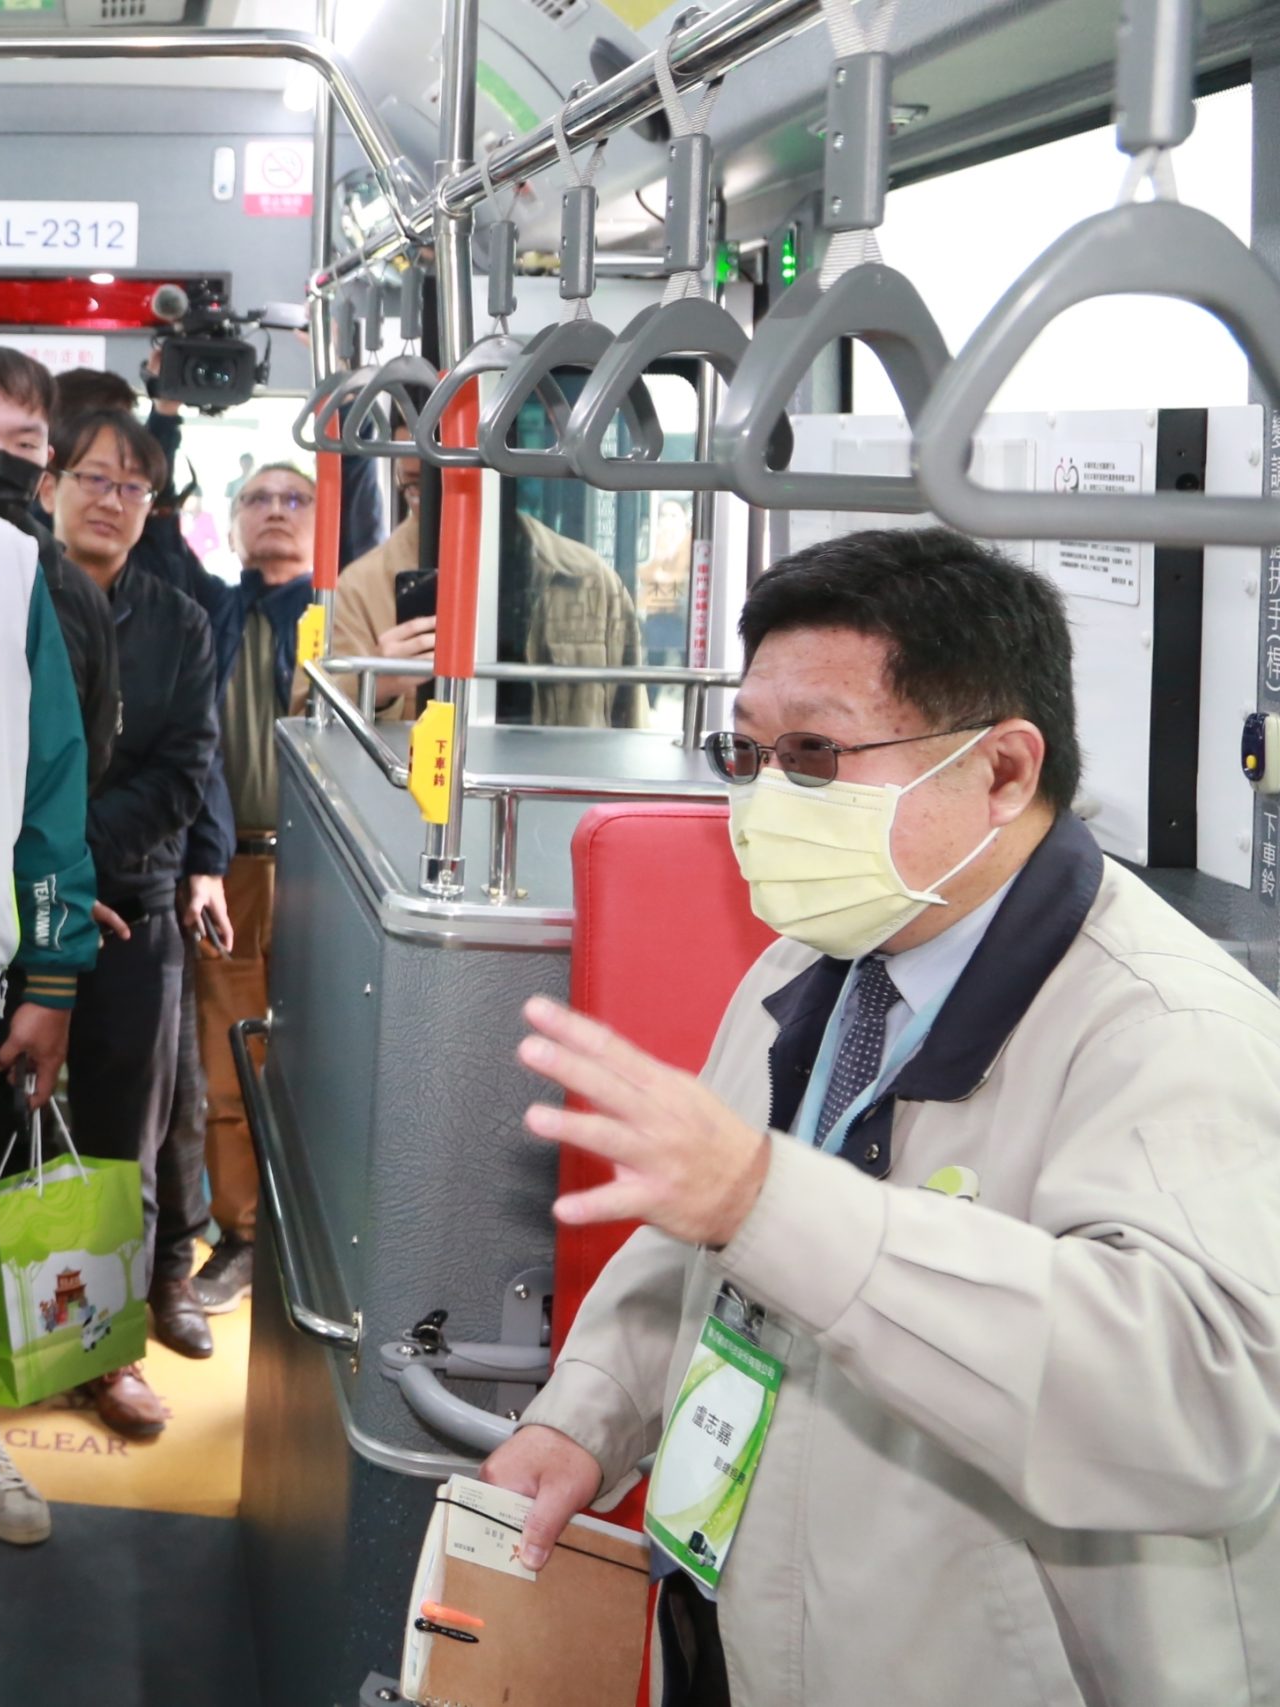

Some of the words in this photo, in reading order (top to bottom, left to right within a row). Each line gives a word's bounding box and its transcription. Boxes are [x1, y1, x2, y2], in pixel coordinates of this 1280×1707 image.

[433, 739, 448, 787] 下車鈴
[5, 1427, 129, 1457] CLEAR
